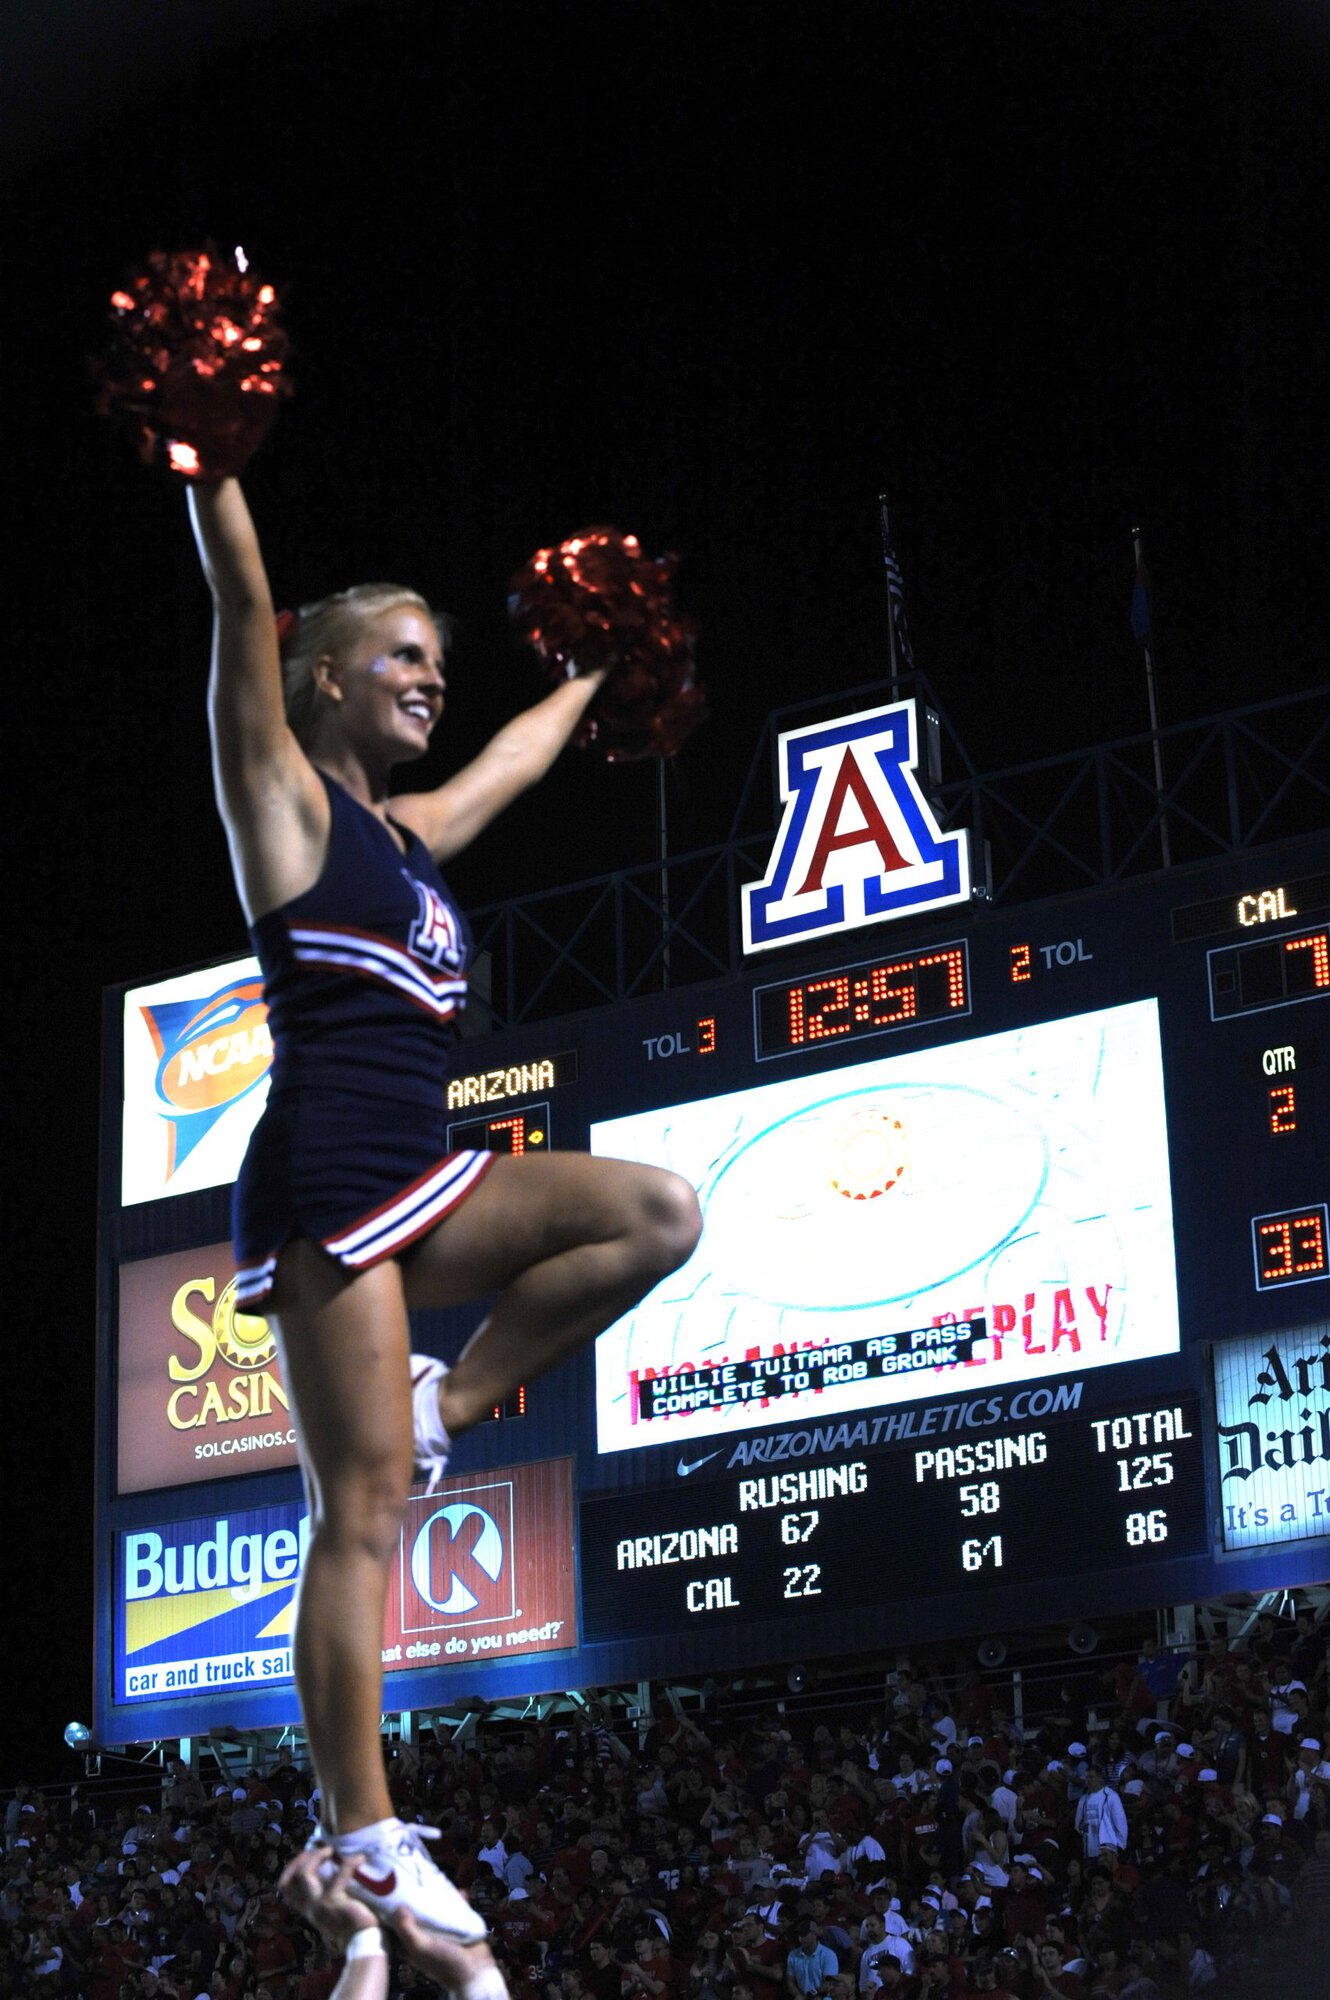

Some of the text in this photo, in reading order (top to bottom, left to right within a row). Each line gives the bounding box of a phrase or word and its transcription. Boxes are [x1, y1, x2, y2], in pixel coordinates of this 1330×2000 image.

[742, 698, 971, 955] A
[1237, 888, 1298, 926] CAL
[1011, 938, 1093, 982] 2 TOL
[1284, 934, 1330, 987] 7
[789, 950, 966, 1044] 12:57
[178, 1023, 273, 1087] NCAA
[642, 1017, 715, 1061] TOL 3
[1262, 1046, 1296, 1075] QTR
[447, 1060, 554, 1110] ARIZONA
[1269, 1086, 1296, 1133] 2
[489, 1116, 524, 1157] 7
[1260, 1216, 1324, 1279] 33
[168, 1276, 279, 1382] SO
[652, 1323, 972, 1395] WILLIE TUITAMA AS PASS
[167, 1371, 290, 1431] CASIN
[653, 1346, 958, 1414] COMPLETE TO ROB GRONK
[1248, 1334, 1330, 1407] Ari
[195, 1429, 297, 1459] SOLCASINOS.C
[727, 1382, 1083, 1469] ARIZONAATHLETICS.COM
[1218, 1407, 1330, 1482] Dail
[739, 1408, 1192, 1511] RUSHING PASSING TOTAL
[617, 1453, 1174, 1570] ARIZONA 67 58 125
[1226, 1502, 1268, 1531] It's
[1280, 1503, 1297, 1522] a
[686, 1510, 1168, 1612] CAL 22 61 86
[406, 1641, 441, 1659] else
[445, 1637, 467, 1654] do
[471, 1634, 502, 1654] you
[506, 1622, 560, 1646] need?
[129, 1651, 291, 1692] car and truck sal
